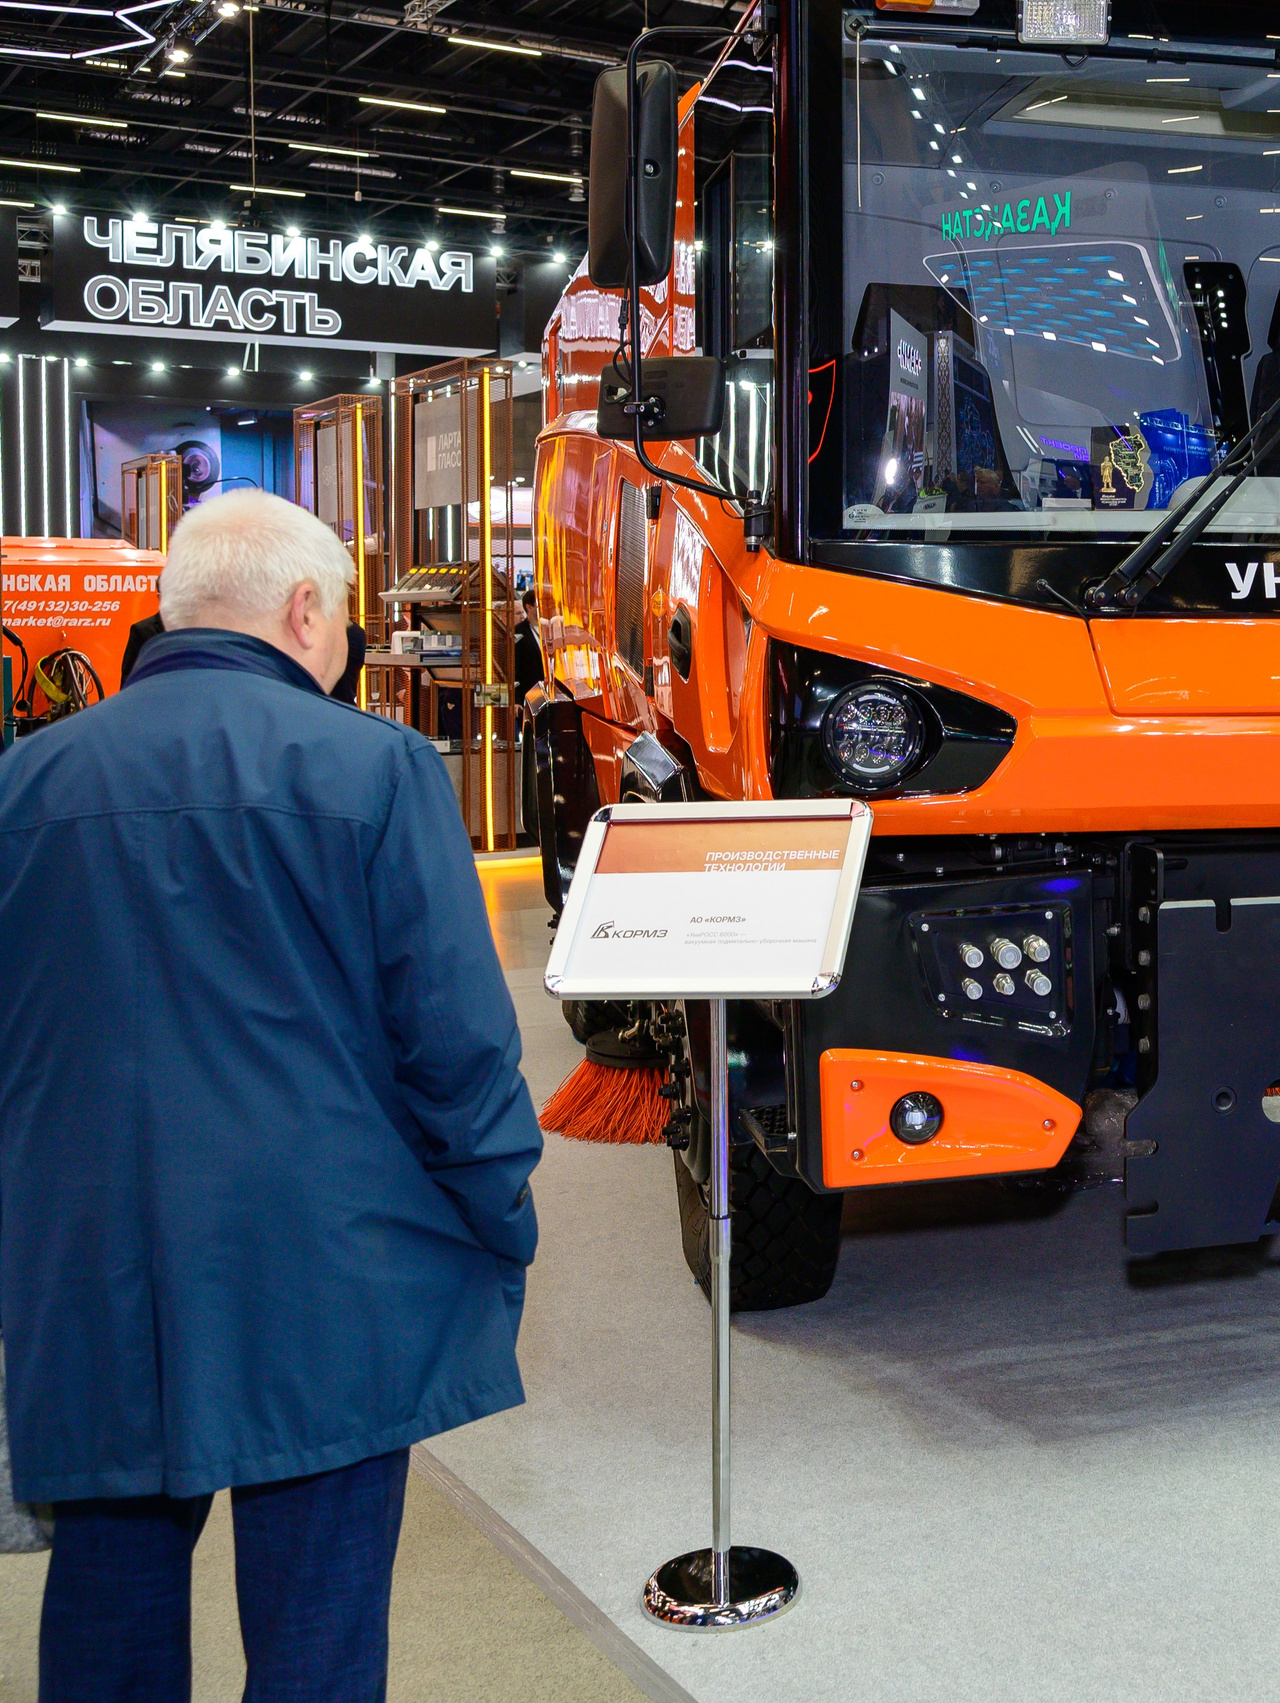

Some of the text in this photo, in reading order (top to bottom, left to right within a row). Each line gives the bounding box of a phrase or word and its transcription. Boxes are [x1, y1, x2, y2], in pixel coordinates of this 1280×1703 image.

[83, 216, 474, 293] ЧЕЛЯБИНСКАЯ
[83, 274, 342, 336] ОБЛАСТЬ
[705, 849, 840, 862] ПРОИЗВОДСТВЕННЫЕ
[704, 862, 786, 872] ТЕХНОЛОГИИ
[690, 916, 703, 924] АО
[611, 929, 668, 939] КОРМЗ
